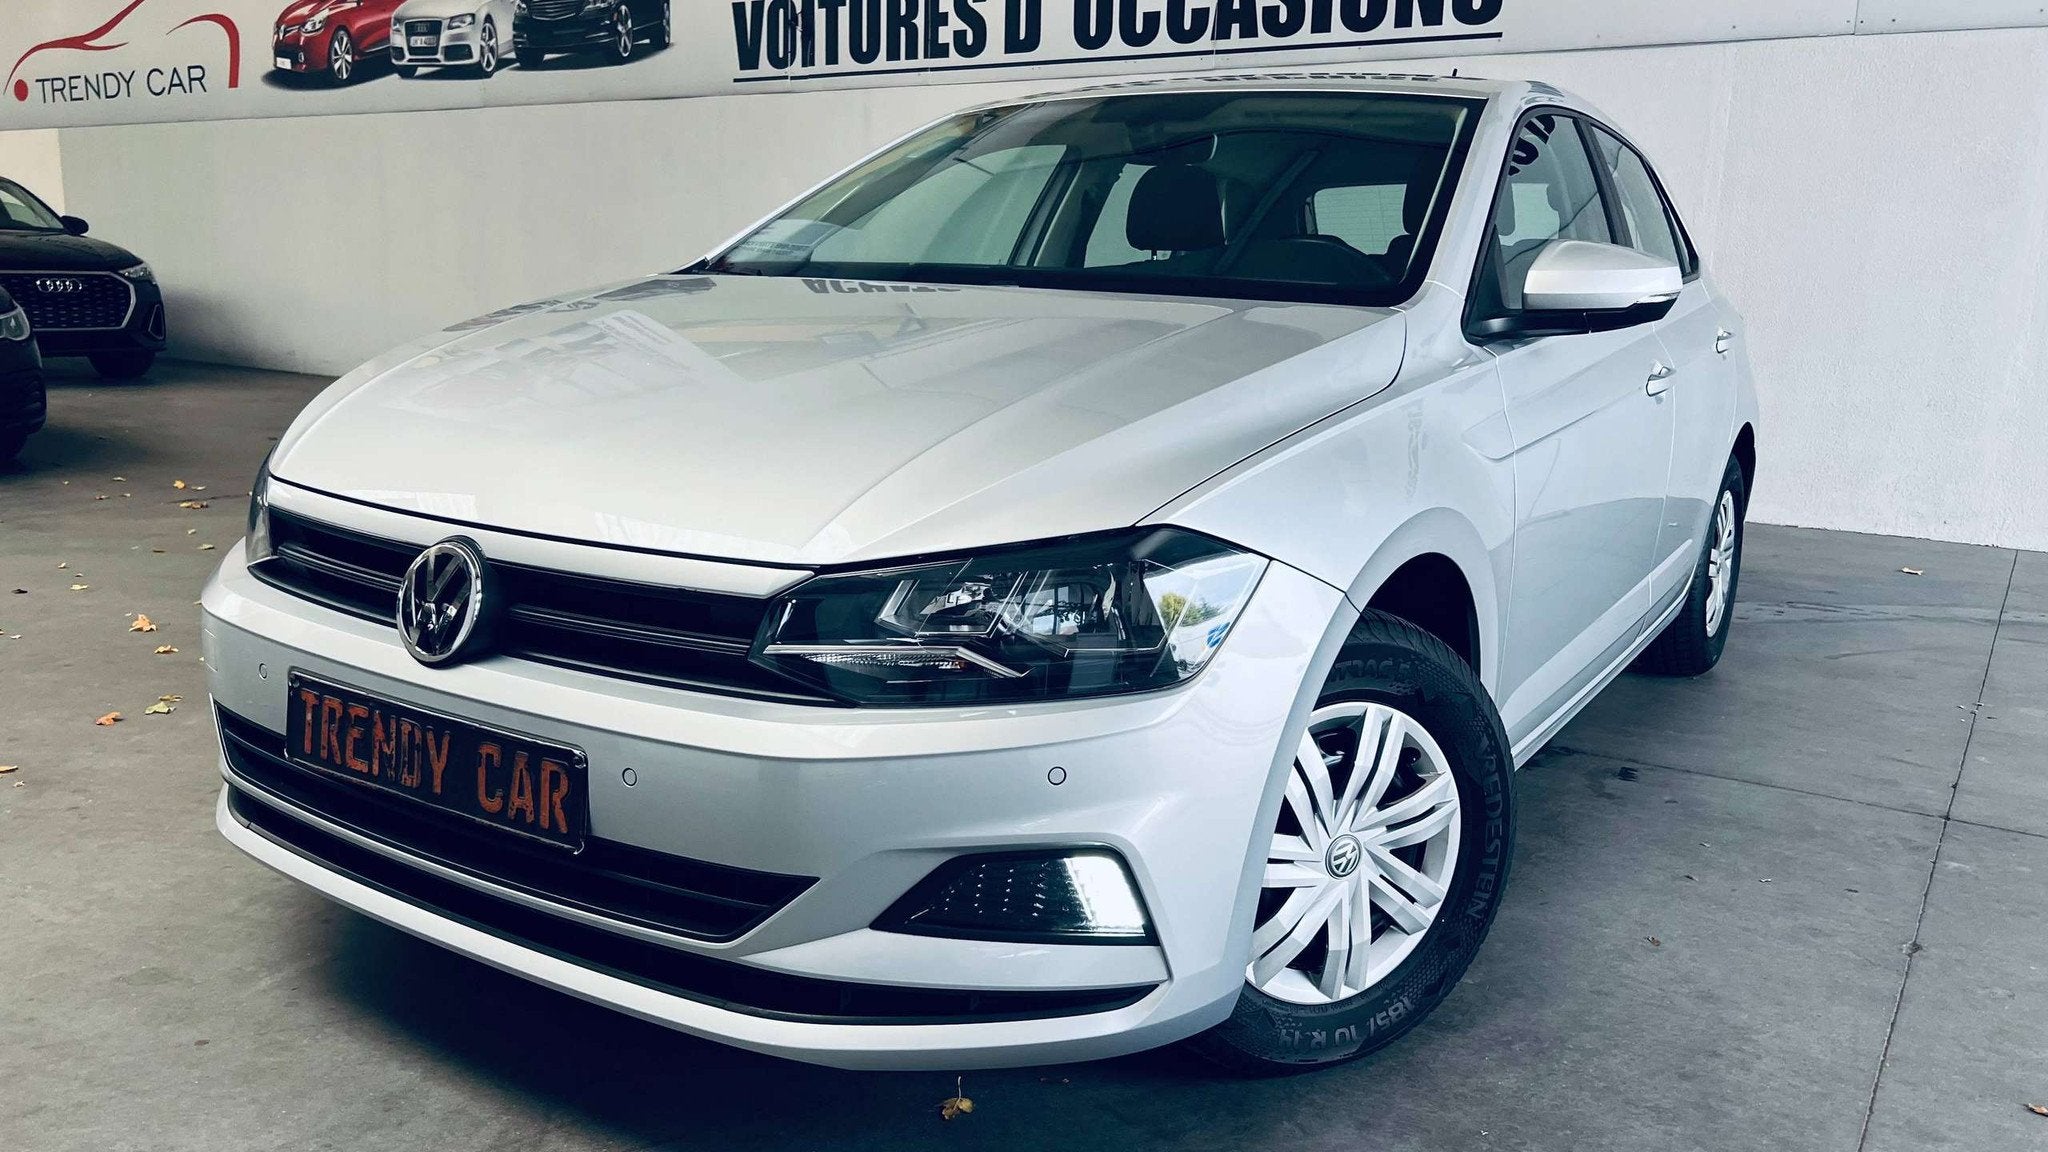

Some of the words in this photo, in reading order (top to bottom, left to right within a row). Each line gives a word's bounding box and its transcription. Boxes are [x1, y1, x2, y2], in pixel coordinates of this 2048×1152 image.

[35, 70, 136, 104] TRENDY
[146, 64, 208, 97] CAR
[731, 0, 987, 71] VOITURES
[301, 687, 451, 796] TRENDY
[477, 741, 570, 834] CAR
[1467, 734, 1503, 919] VREDESTEIN
